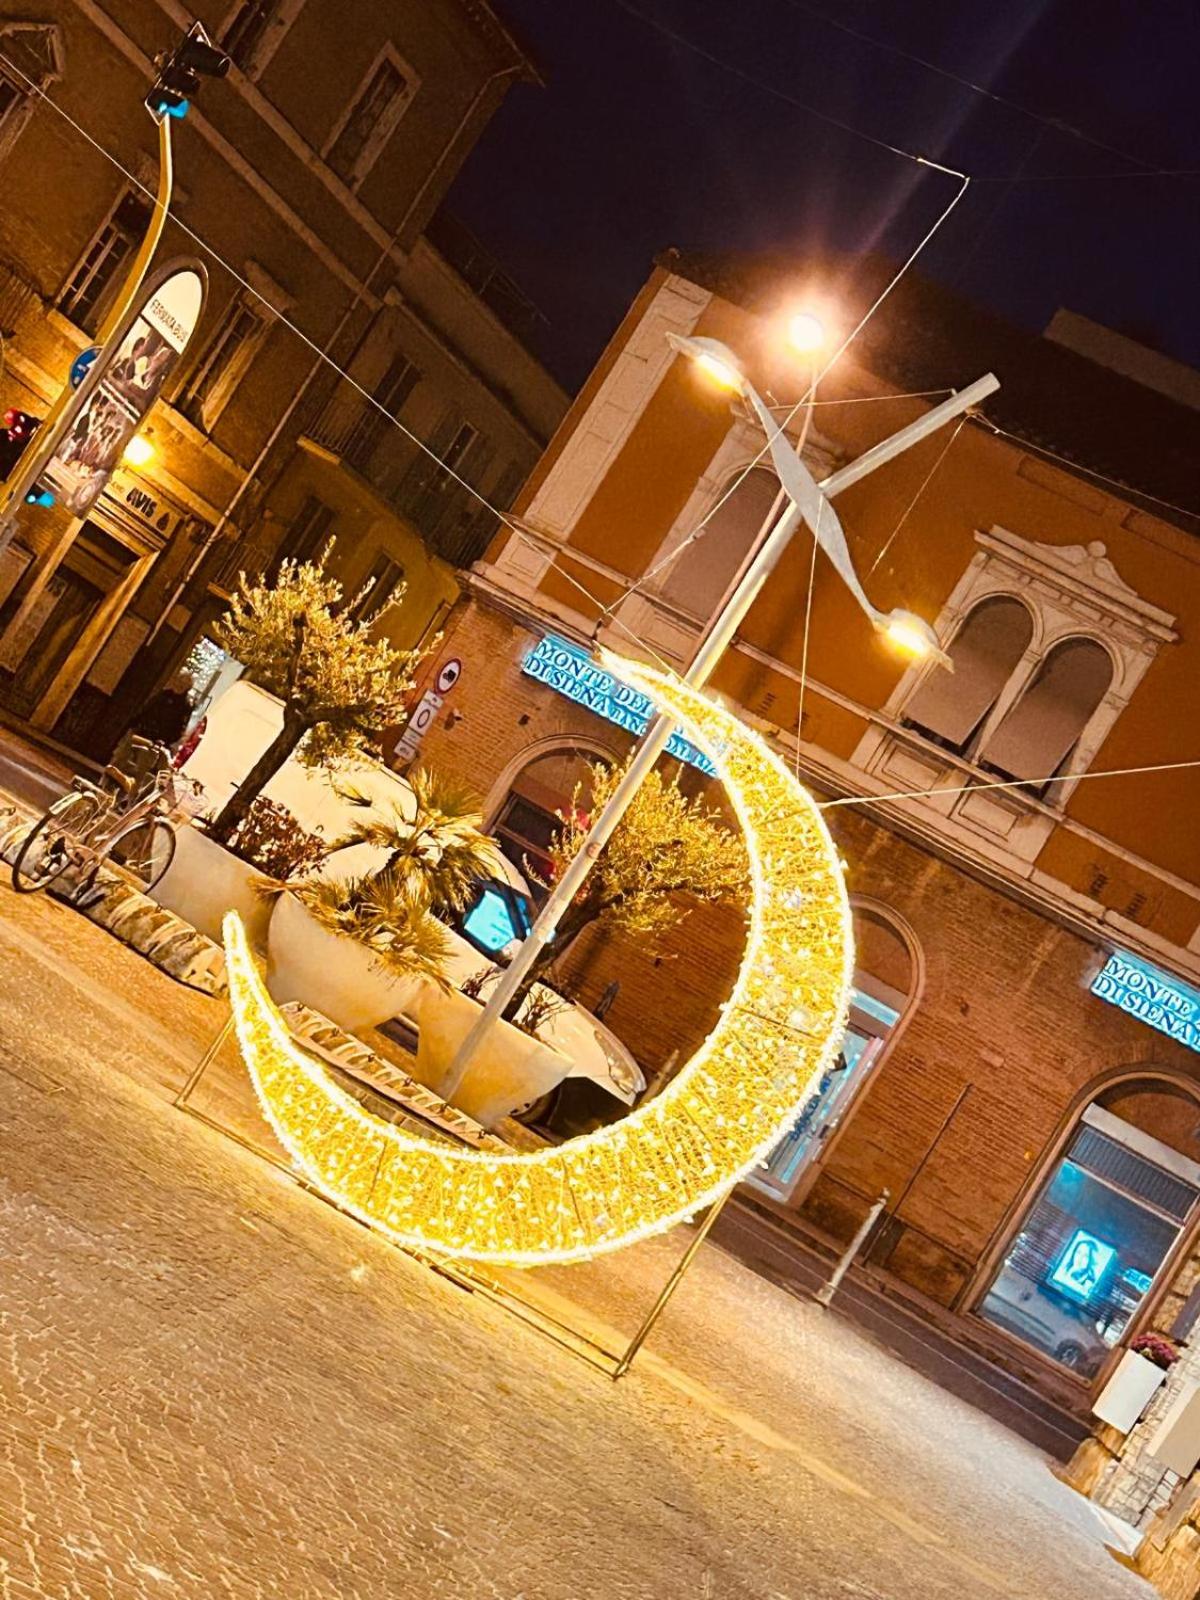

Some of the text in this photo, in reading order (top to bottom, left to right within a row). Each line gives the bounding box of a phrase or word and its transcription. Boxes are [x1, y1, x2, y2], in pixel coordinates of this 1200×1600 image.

[126, 487, 157, 518] AVIS
[525, 656, 549, 680] DI
[549, 667, 608, 712] SIENA
[535, 641, 653, 715] MONTE DEI
[1095, 975, 1121, 999] DI
[1123, 991, 1188, 1040] SIENA
[1104, 959, 1193, 1018] MONTE
